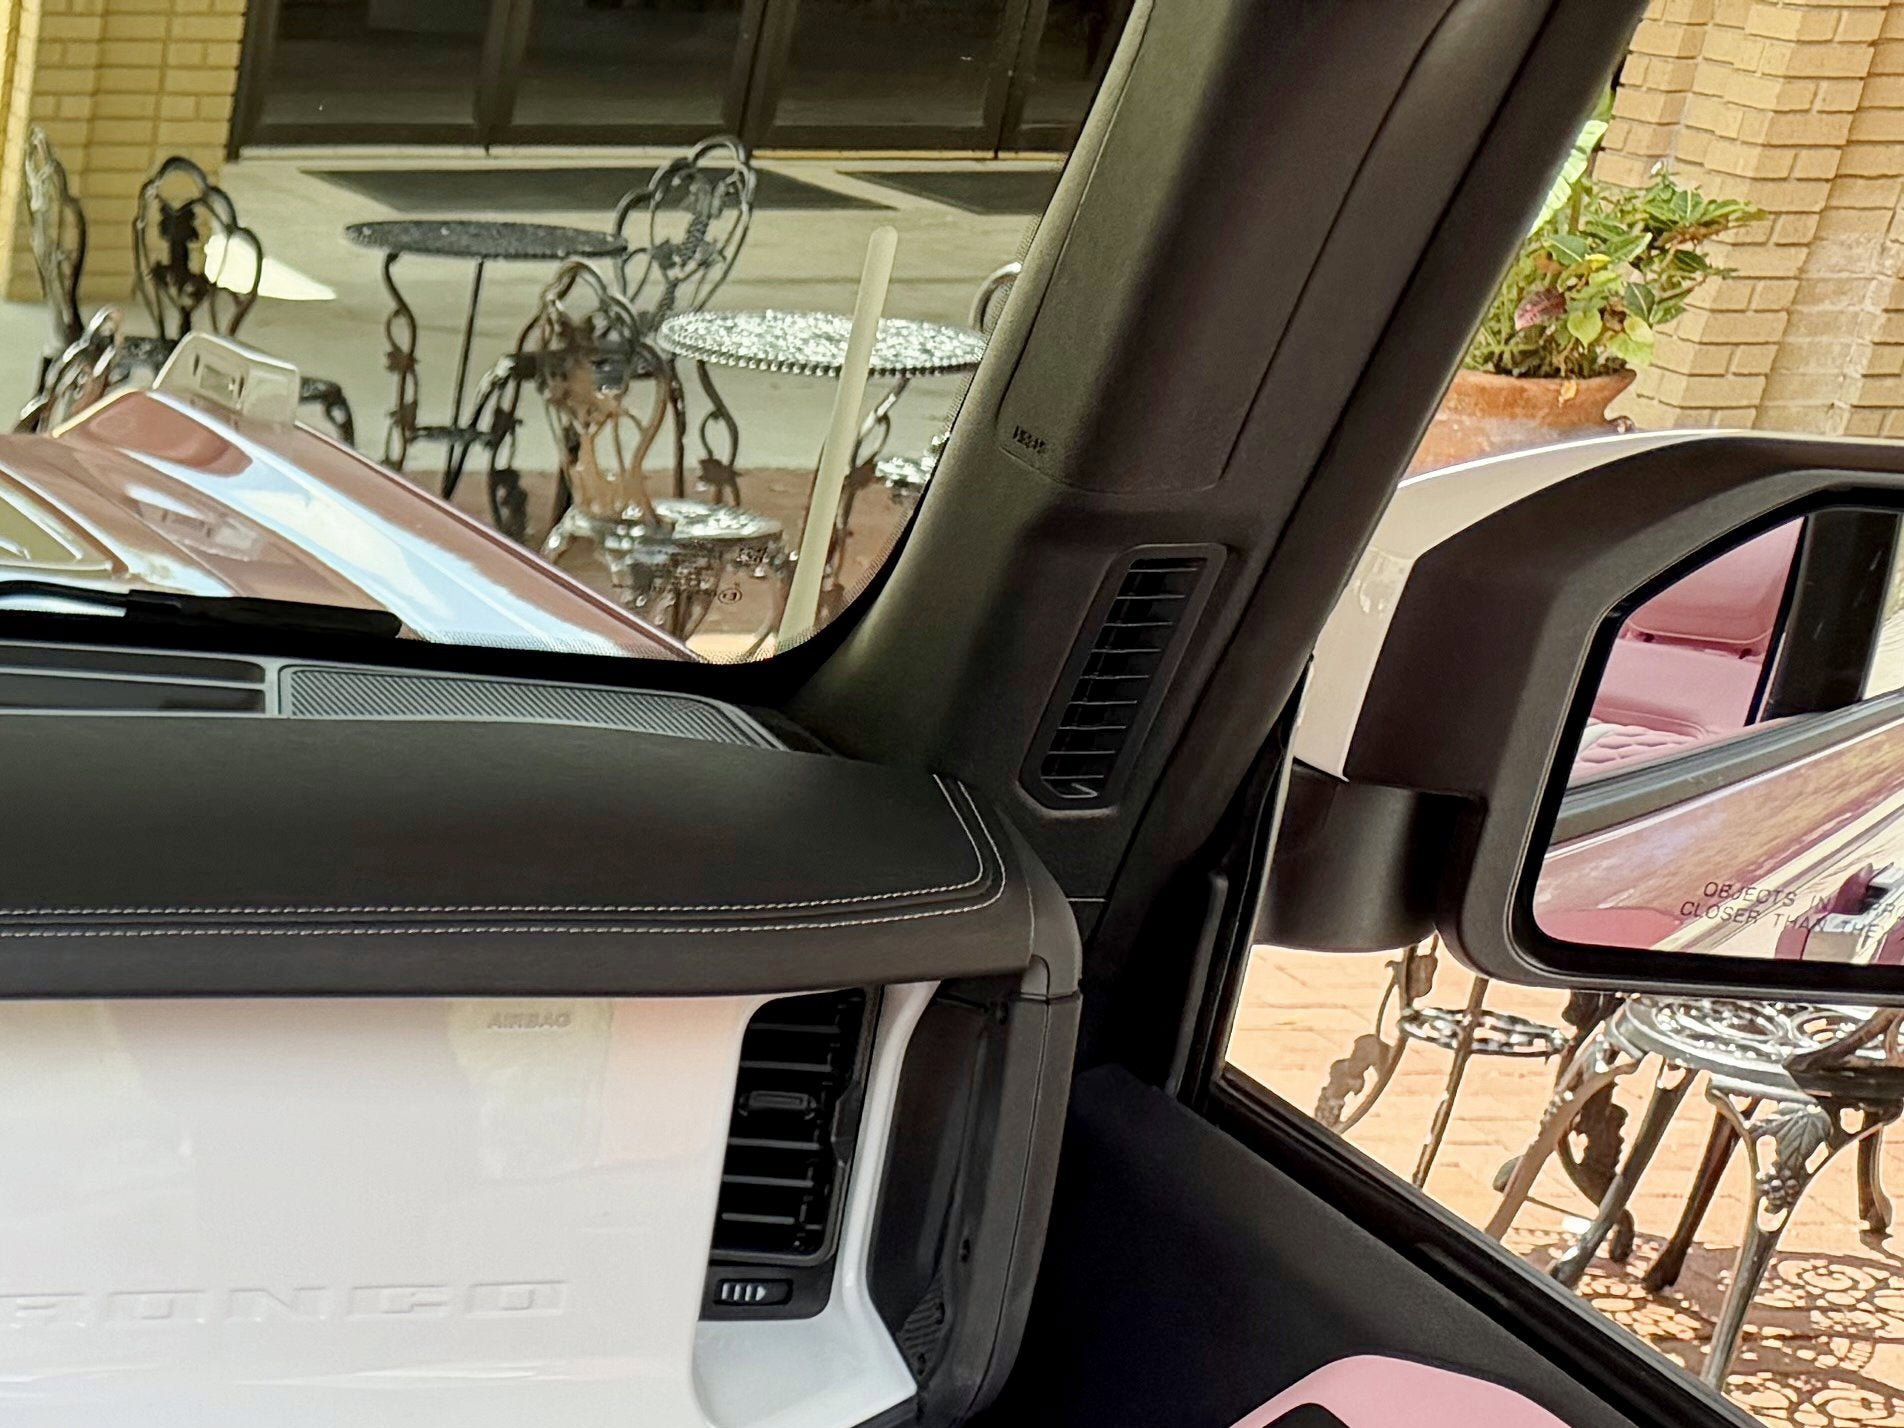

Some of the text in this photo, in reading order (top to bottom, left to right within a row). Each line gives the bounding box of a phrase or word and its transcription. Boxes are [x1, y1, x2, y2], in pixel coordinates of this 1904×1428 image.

[1703, 881, 1797, 907] OBJECTS
[1809, 895, 1831, 910] IN
[1680, 901, 1760, 924] CLOSER
[1773, 913, 1826, 931] THAN
